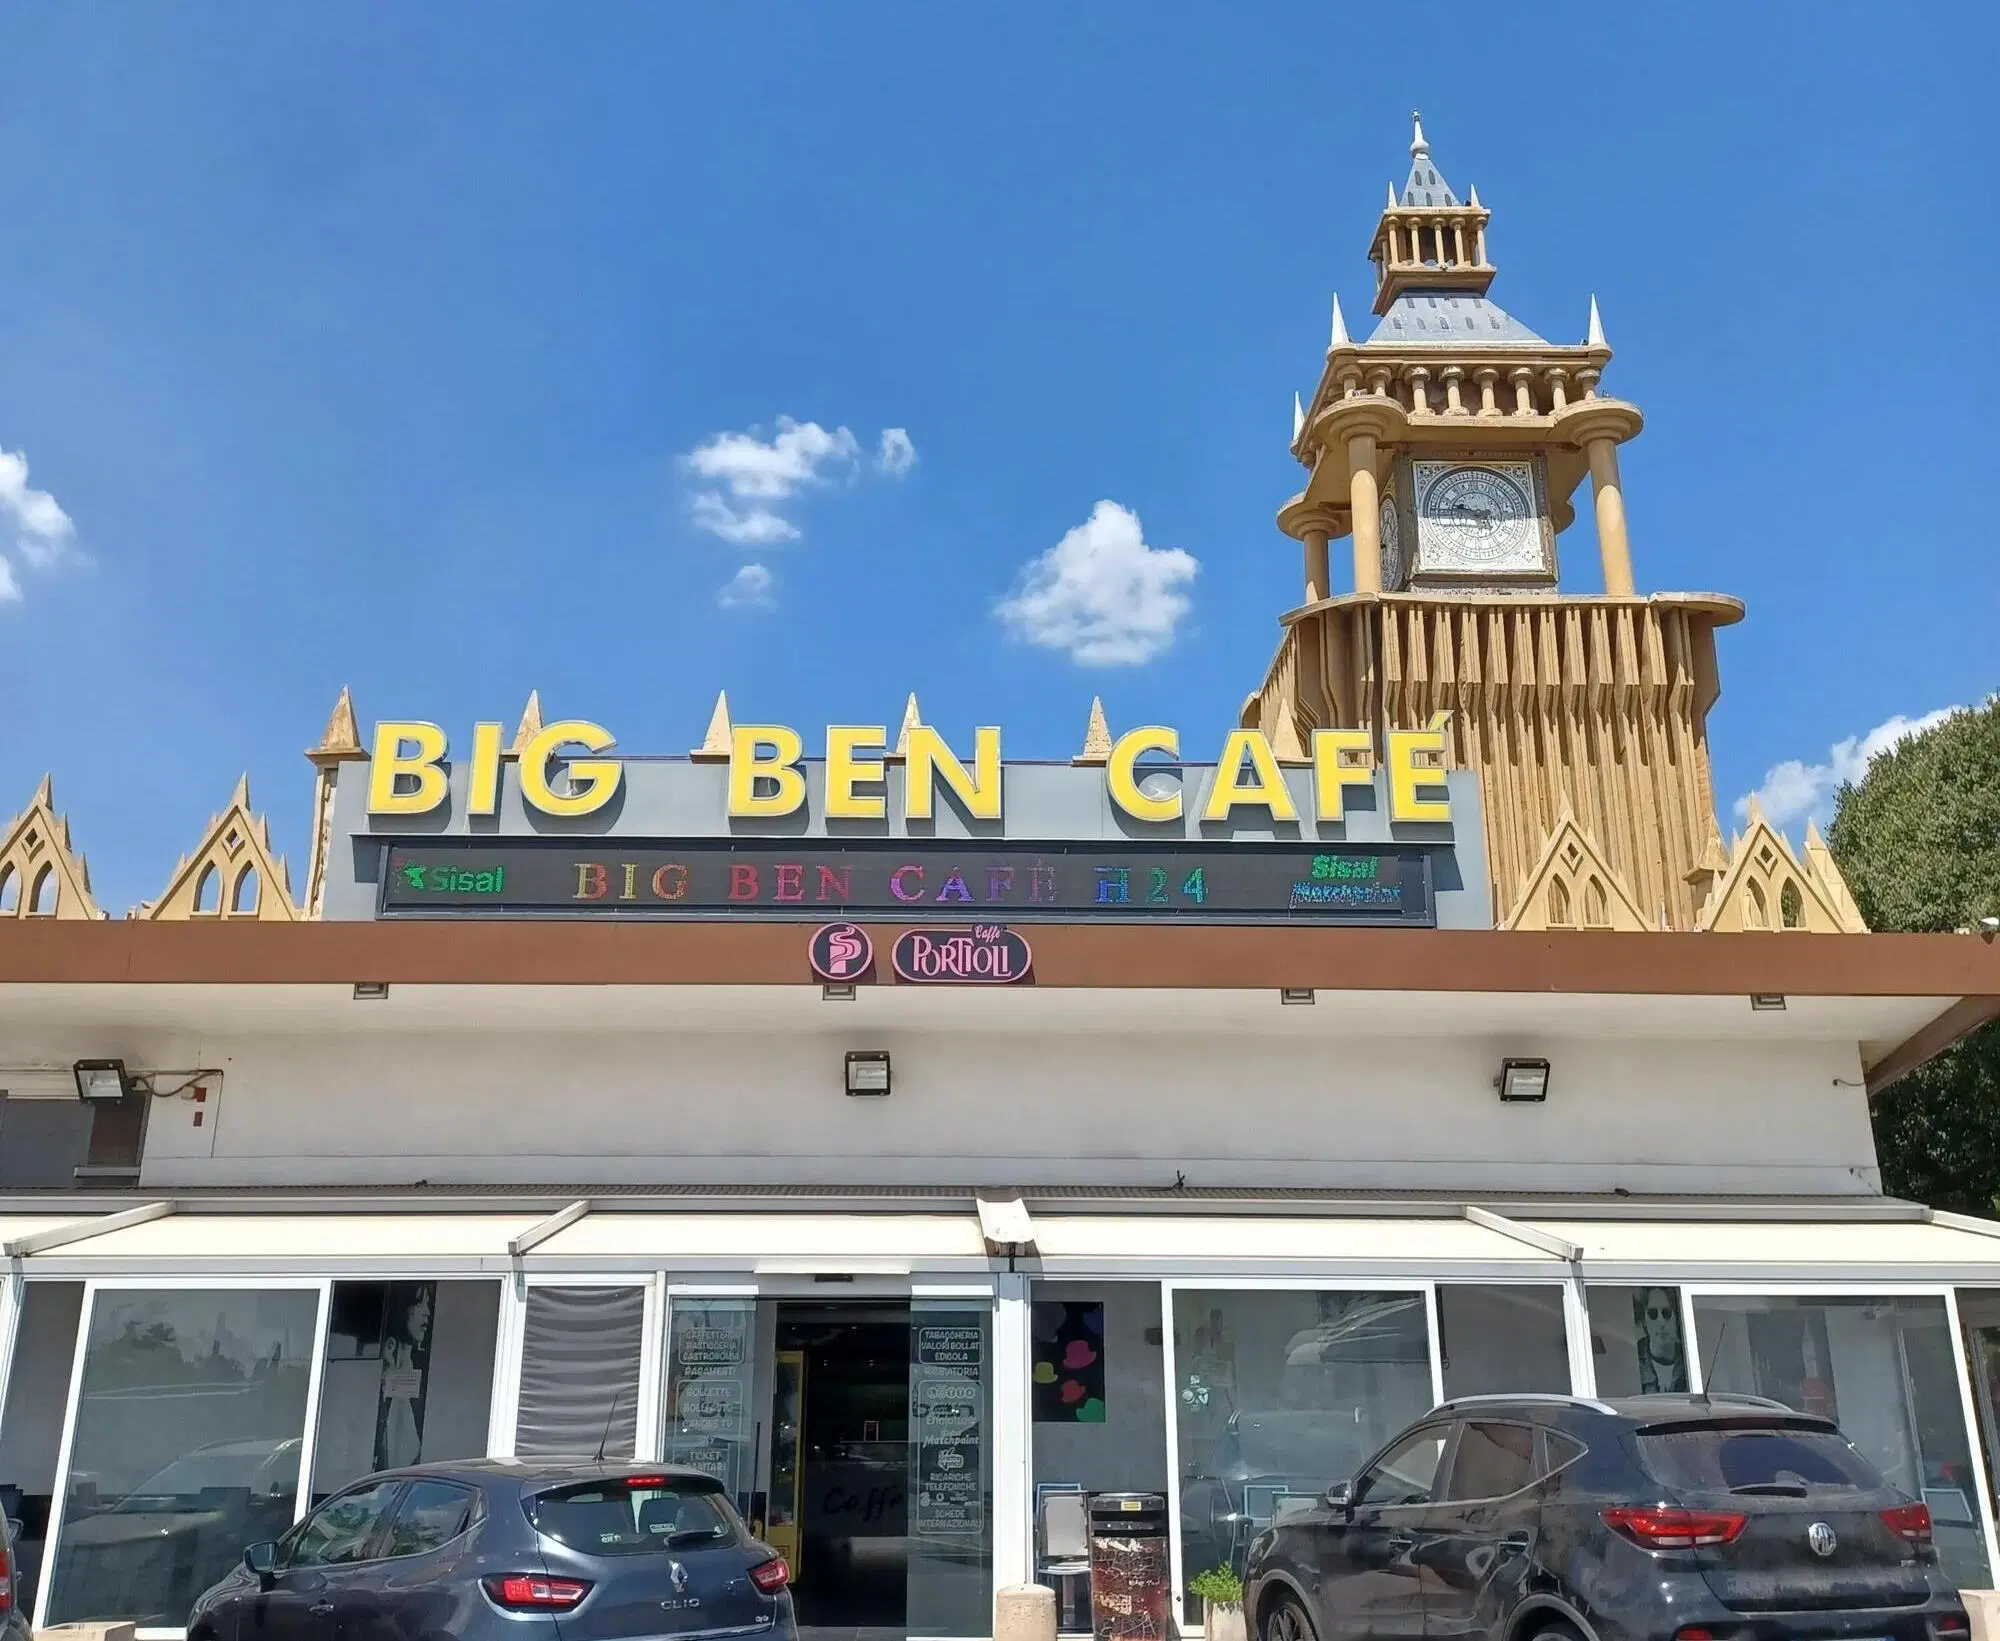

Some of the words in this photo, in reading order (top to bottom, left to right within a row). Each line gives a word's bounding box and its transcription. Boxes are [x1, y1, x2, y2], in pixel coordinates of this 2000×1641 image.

[367, 719, 624, 817] BIG
[728, 723, 1002, 819] BEN
[1106, 710, 1453, 822] CAFÉ
[429, 864, 504, 893] Sisal
[1312, 854, 1378, 879] Sisal
[573, 862, 688, 900] BIG
[727, 863, 854, 901] BEN
[912, 935, 1012, 977] PORTIOLI
[925, 1331, 978, 1339] TABACCHERIA
[930, 1472, 972, 1481] RICARICHE
[661, 1598, 700, 1610] CLIO
